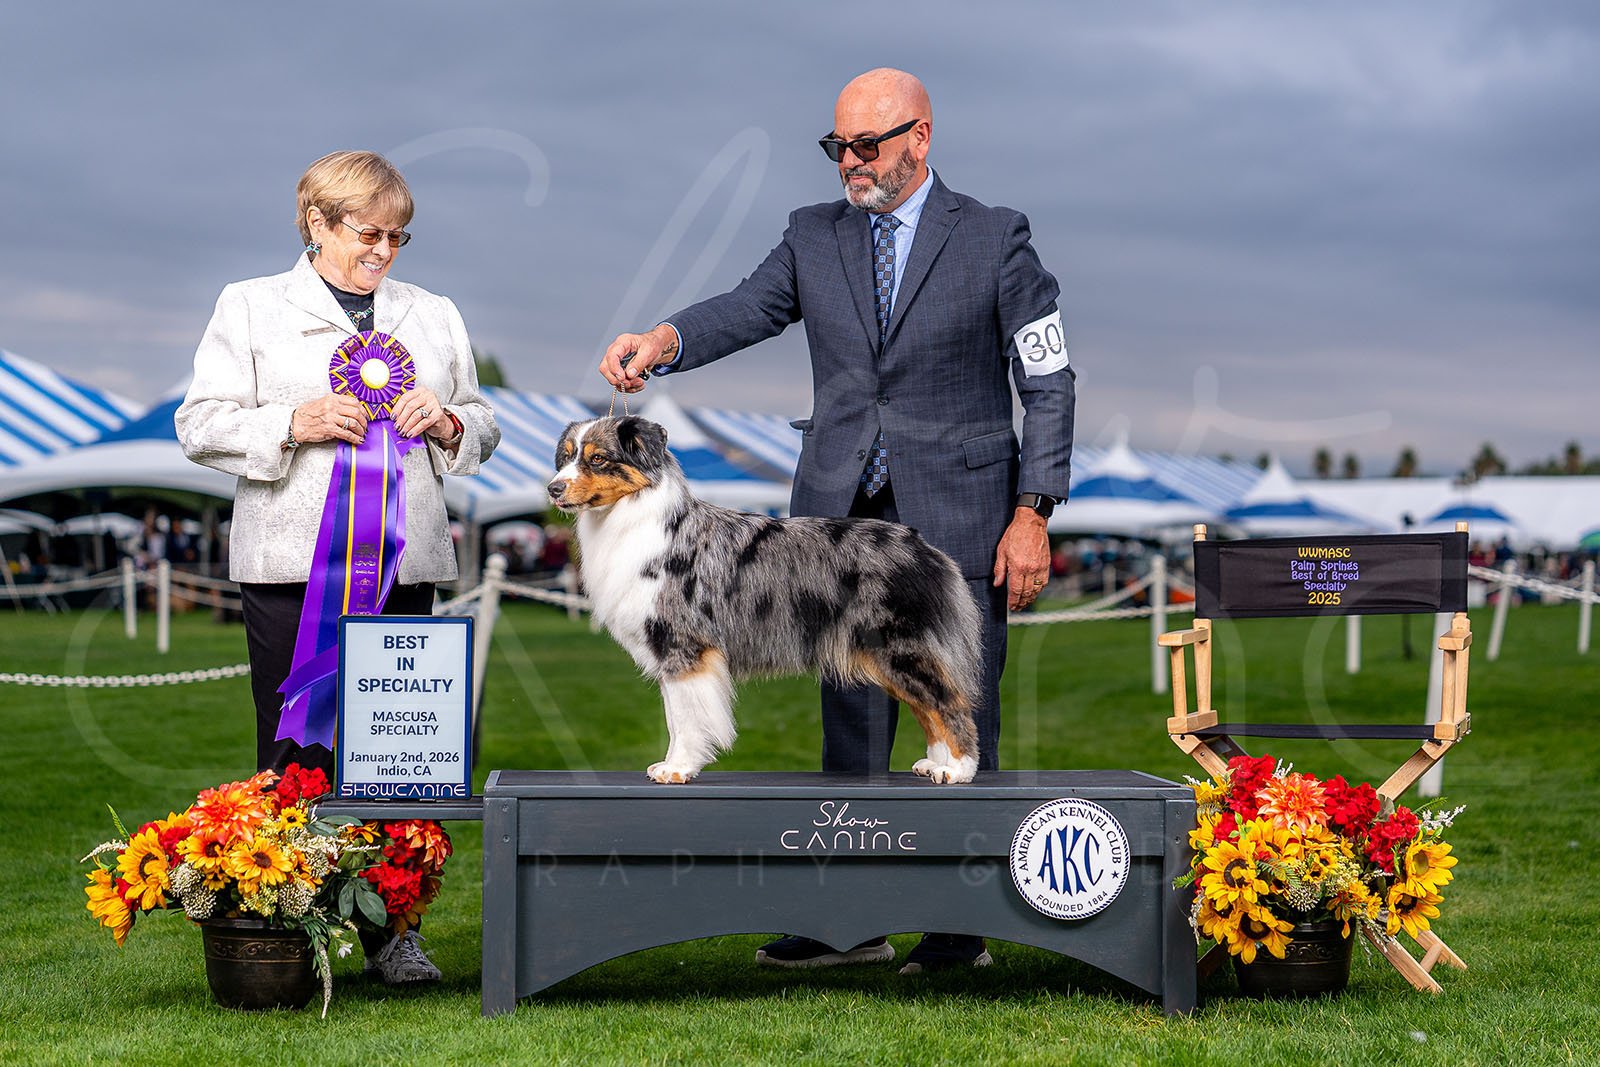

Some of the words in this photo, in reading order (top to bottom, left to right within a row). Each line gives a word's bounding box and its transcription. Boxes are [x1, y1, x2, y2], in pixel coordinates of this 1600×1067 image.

[1023, 317, 1066, 362] 30
[1298, 547, 1351, 558] WWMASC
[1290, 560, 1316, 571] Palm
[1320, 560, 1359, 571] Springs
[1291, 570, 1313, 581] Best
[1317, 571, 1328, 581] of
[1331, 570, 1359, 581] Breed
[1303, 581, 1347, 591] Specialty
[1308, 592, 1341, 604] 2025
[383, 635, 429, 650] BEST
[397, 657, 415, 671] IN
[357, 678, 454, 693] SPECIALTY
[372, 711, 437, 722] MASCUSA
[370, 724, 439, 736] SPECIALTY
[349, 751, 397, 765] January
[400, 751, 426, 764] 2nd,
[429, 752, 460, 763] 2026
[376, 765, 411, 777] Indio,
[413, 765, 432, 776] CA
[341, 783, 466, 797] SHOWCANINE
[812, 801, 889, 829] Show
[780, 830, 917, 850] CANINE
[1018, 810, 1057, 871] AMERICAN
[1060, 806, 1107, 832] KENNEL
[1106, 830, 1121, 864] CLUB
[1037, 825, 1104, 897] AKC
[1036, 894, 1084, 912] FOUNDED
[1088, 890, 1108, 907] 1884
